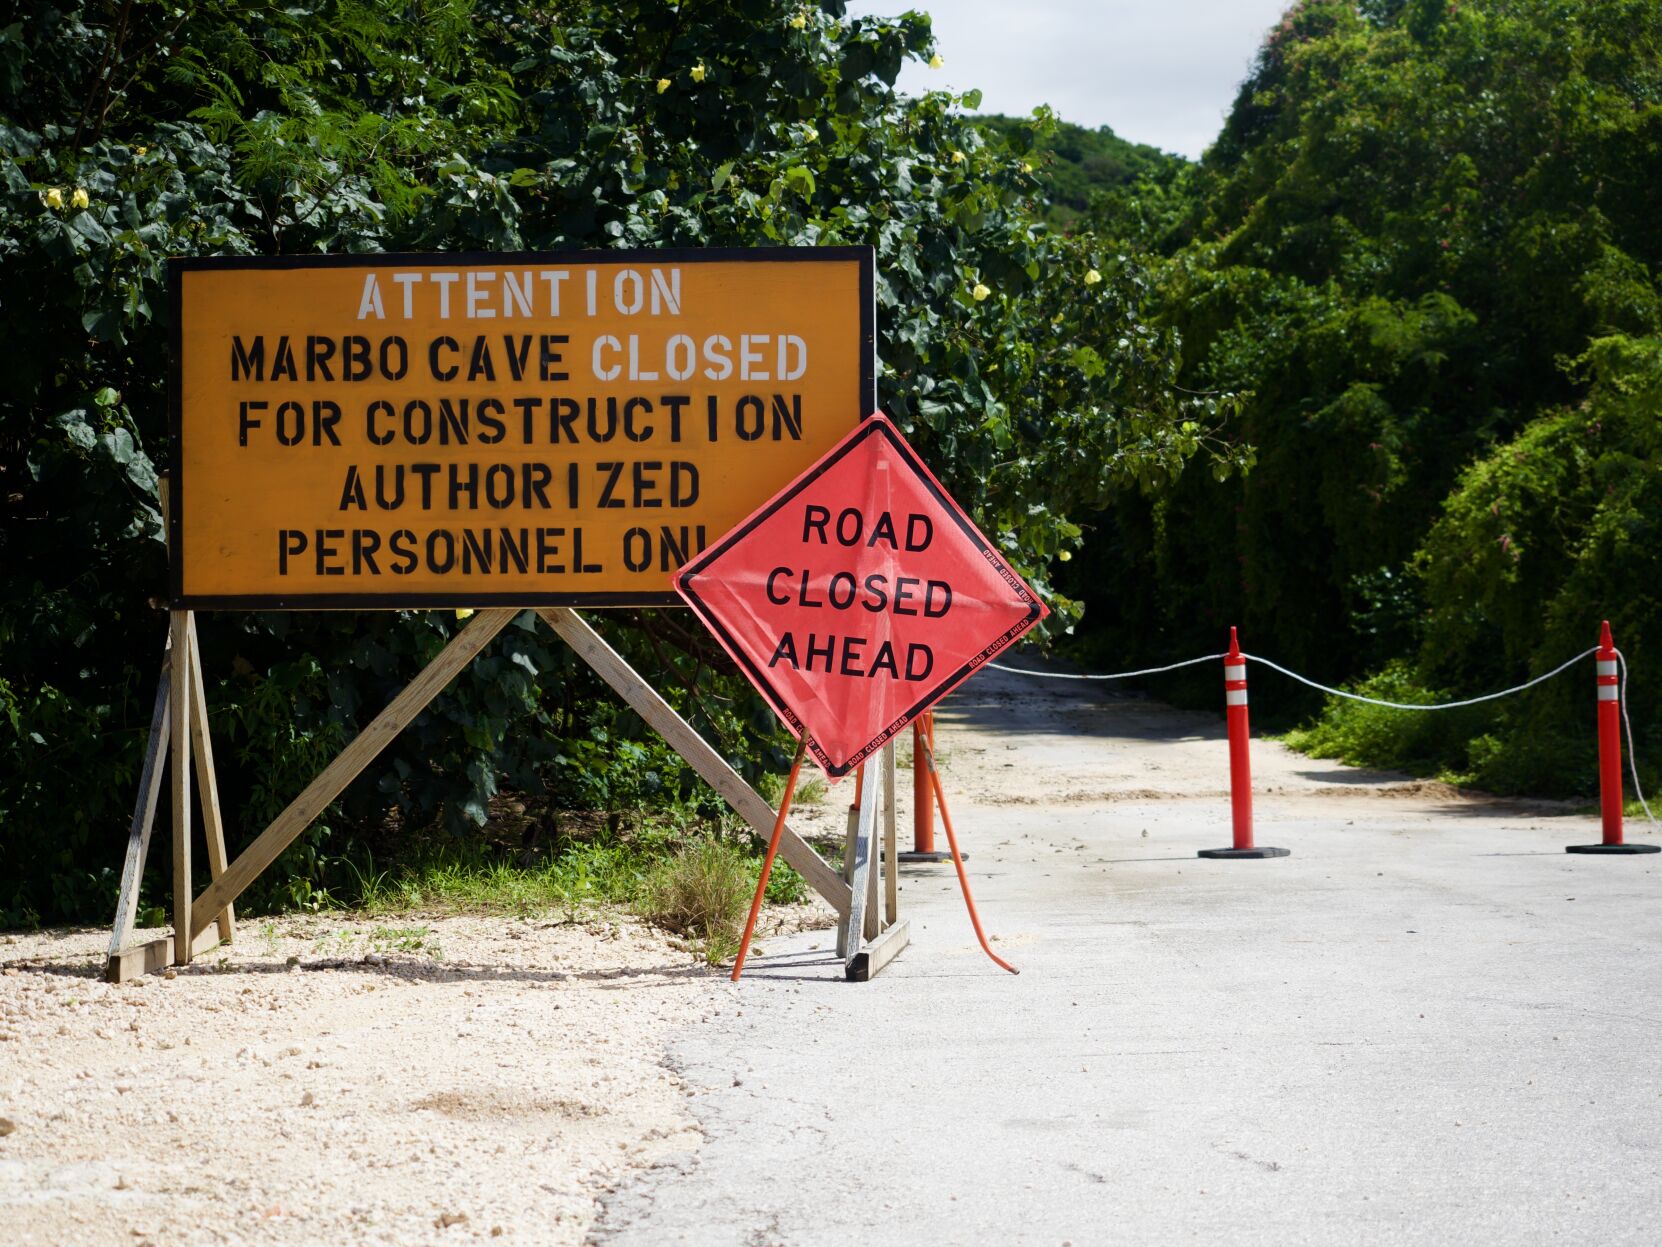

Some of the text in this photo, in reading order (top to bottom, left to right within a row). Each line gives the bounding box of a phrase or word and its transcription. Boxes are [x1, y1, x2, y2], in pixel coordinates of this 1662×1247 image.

[358, 269, 681, 319] ATTENTION
[231, 334, 807, 382] MARBO CAVE CLOSED
[239, 395, 803, 447] FOR CONSTRUCTION
[339, 461, 700, 511] AUTHORIZED
[279, 528, 603, 575] PERSONNEL
[802, 504, 934, 552] ROAD
[983, 549, 1001, 568] AHEAD
[999, 568, 1020, 590] CLOSED
[766, 567, 953, 618] CLOSED
[769, 632, 934, 682] AHEAD
[968, 619, 1030, 669] ROAD CLOSED AHEAD
[782, 708, 797, 724] ROAD
[814, 748, 831, 769] AHEAD
[847, 715, 909, 767] ROAD CLOSED AHEAD
